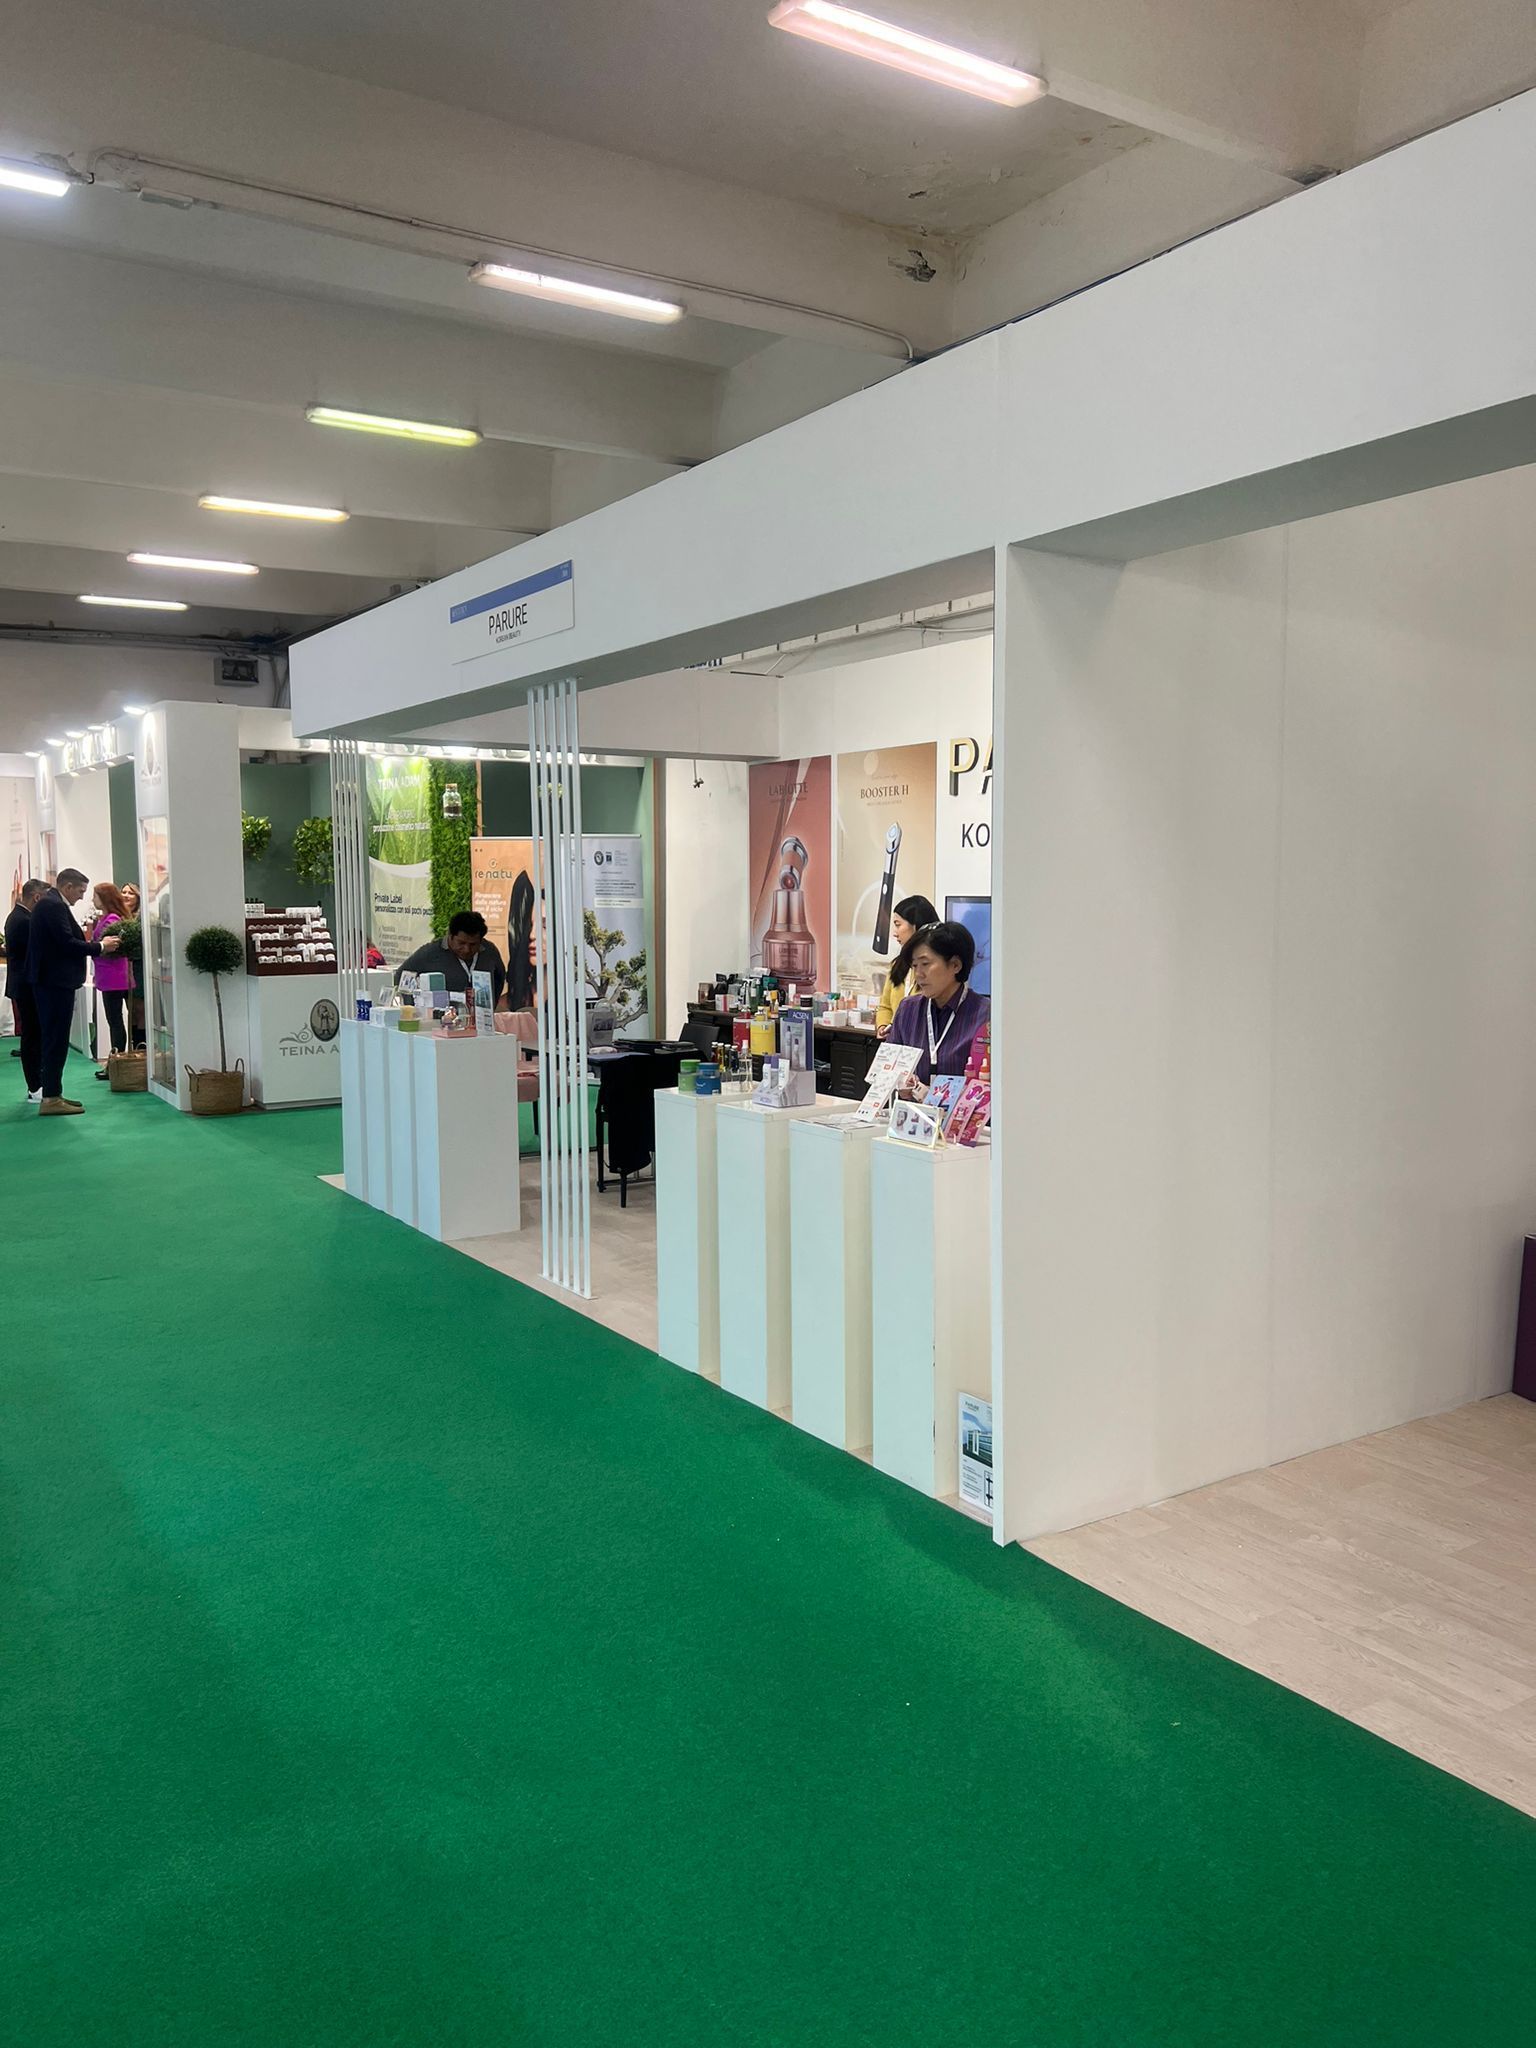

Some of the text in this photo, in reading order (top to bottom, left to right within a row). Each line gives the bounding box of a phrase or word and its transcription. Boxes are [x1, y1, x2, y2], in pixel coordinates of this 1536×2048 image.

[488, 603, 528, 635] PARURE
[495, 630, 521, 644] KOREAN BEAUTY
[860, 784, 909, 799] BOOSTER H
[375, 893, 403, 904] Private Label
[279, 1045, 326, 1057] TEINA
